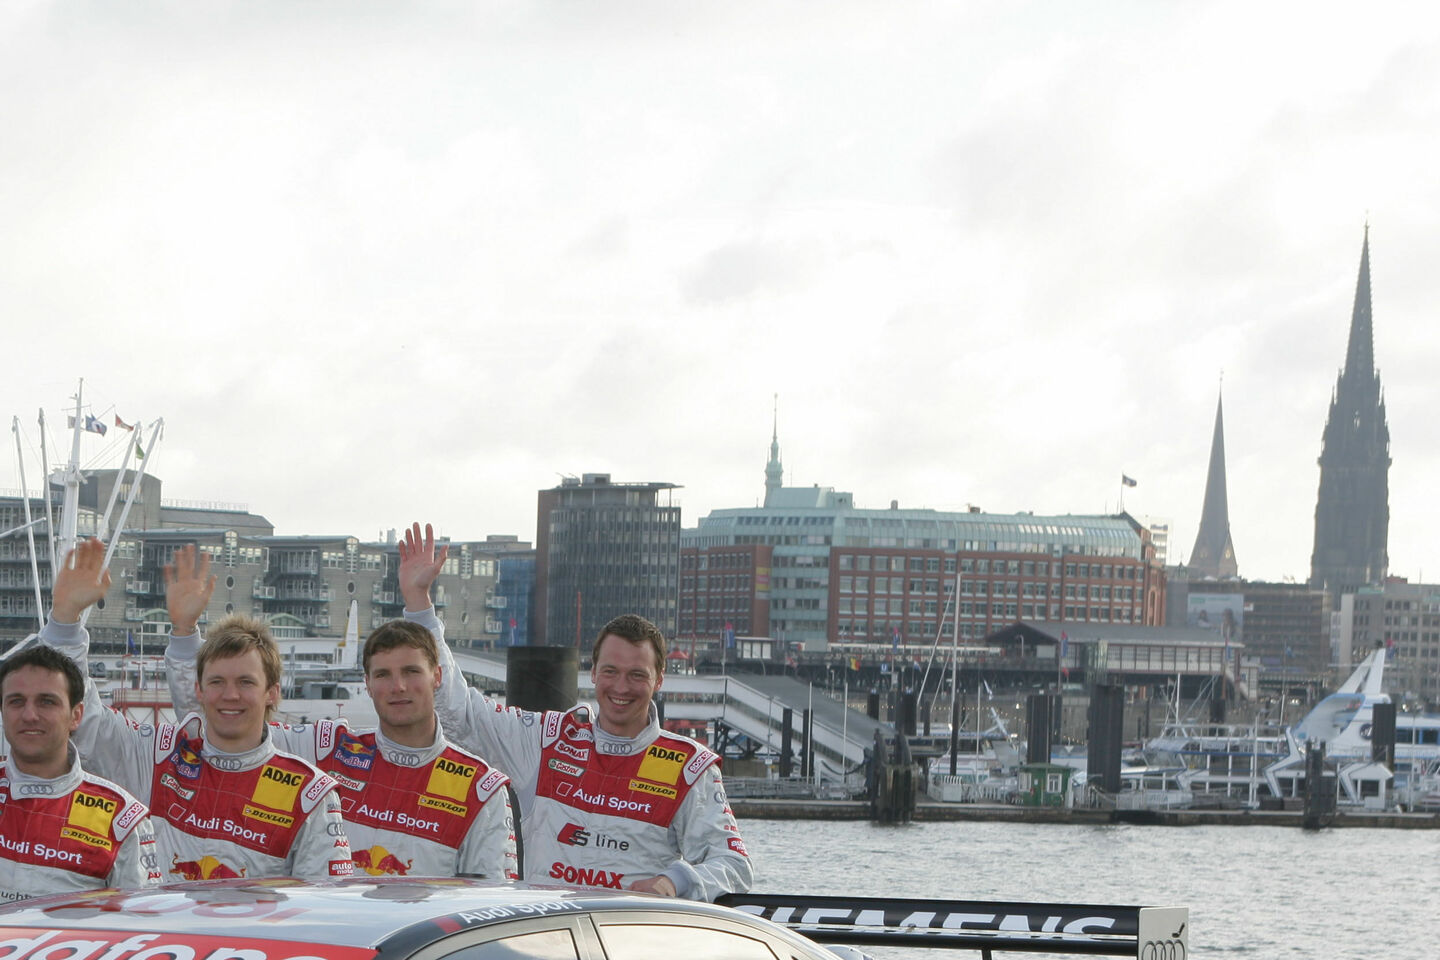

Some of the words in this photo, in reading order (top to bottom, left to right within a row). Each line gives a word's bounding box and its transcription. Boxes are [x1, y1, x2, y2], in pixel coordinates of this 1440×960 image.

[558, 743, 587, 759] SONAX
[648, 746, 685, 763] ADAC
[262, 767, 302, 787] ADAC
[436, 760, 474, 778] ADAC
[637, 782, 675, 797] DUNLOP
[75, 793, 115, 813] ADAC
[427, 799, 466, 813] DUNLOP
[573, 789, 605, 806] Audi
[608, 797, 651, 814] Sport
[252, 809, 292, 826] DUNLOP
[357, 804, 393, 822] Audi
[397, 813, 440, 832] Sport
[184, 813, 220, 831] Audi
[223, 820, 267, 844] Sport
[70, 830, 111, 847] DUNLOP
[596, 833, 629, 851] line
[33, 843, 82, 864] Sport
[549, 862, 625, 889] SONAX
[459, 905, 515, 924] Audi
[511, 899, 583, 916] Sport
